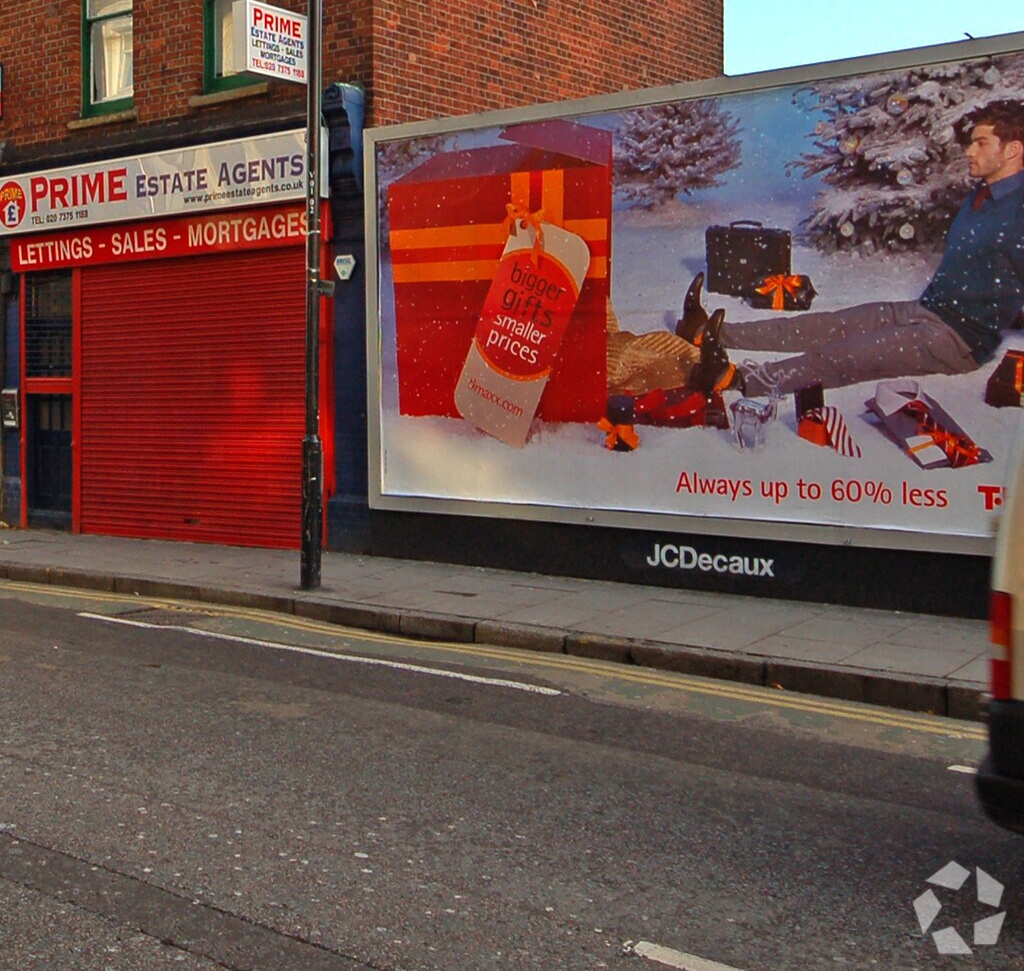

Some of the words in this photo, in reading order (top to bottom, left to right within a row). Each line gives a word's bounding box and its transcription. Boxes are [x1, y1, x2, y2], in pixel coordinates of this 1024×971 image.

[251, 27, 276, 42] ESTATE
[278, 34, 304, 49] AGENTS
[253, 7, 301, 38] PRIME
[252, 39, 280, 53] LETTINGS
[285, 47, 303, 59] SALES
[260, 50, 296, 66] MORTGAGES
[0, 188, 23, 202] PRIME
[30, 168, 128, 213] PRIME
[136, 169, 208, 198] ESTATE
[218, 154, 304, 188] AGENTS
[184, 180, 304, 204] www.primeestateagents.co.uk
[31, 215, 45, 225] TEL:
[46, 213, 58, 223] 020
[18, 236, 93, 265] LETTINGS
[111, 228, 167, 255] SALES
[188, 212, 307, 247] MORTGAGES
[510, 261, 566, 301] bigger
[501, 288, 555, 328] gifts
[493, 314, 546, 346] smaller
[486, 329, 539, 364] prices
[676, 472, 752, 501] Always
[760, 481, 788, 505] up
[797, 478, 821, 500] to
[831, 480, 892, 504] 60%
[902, 480, 948, 507] less
[646, 544, 774, 577] JCDecaux
